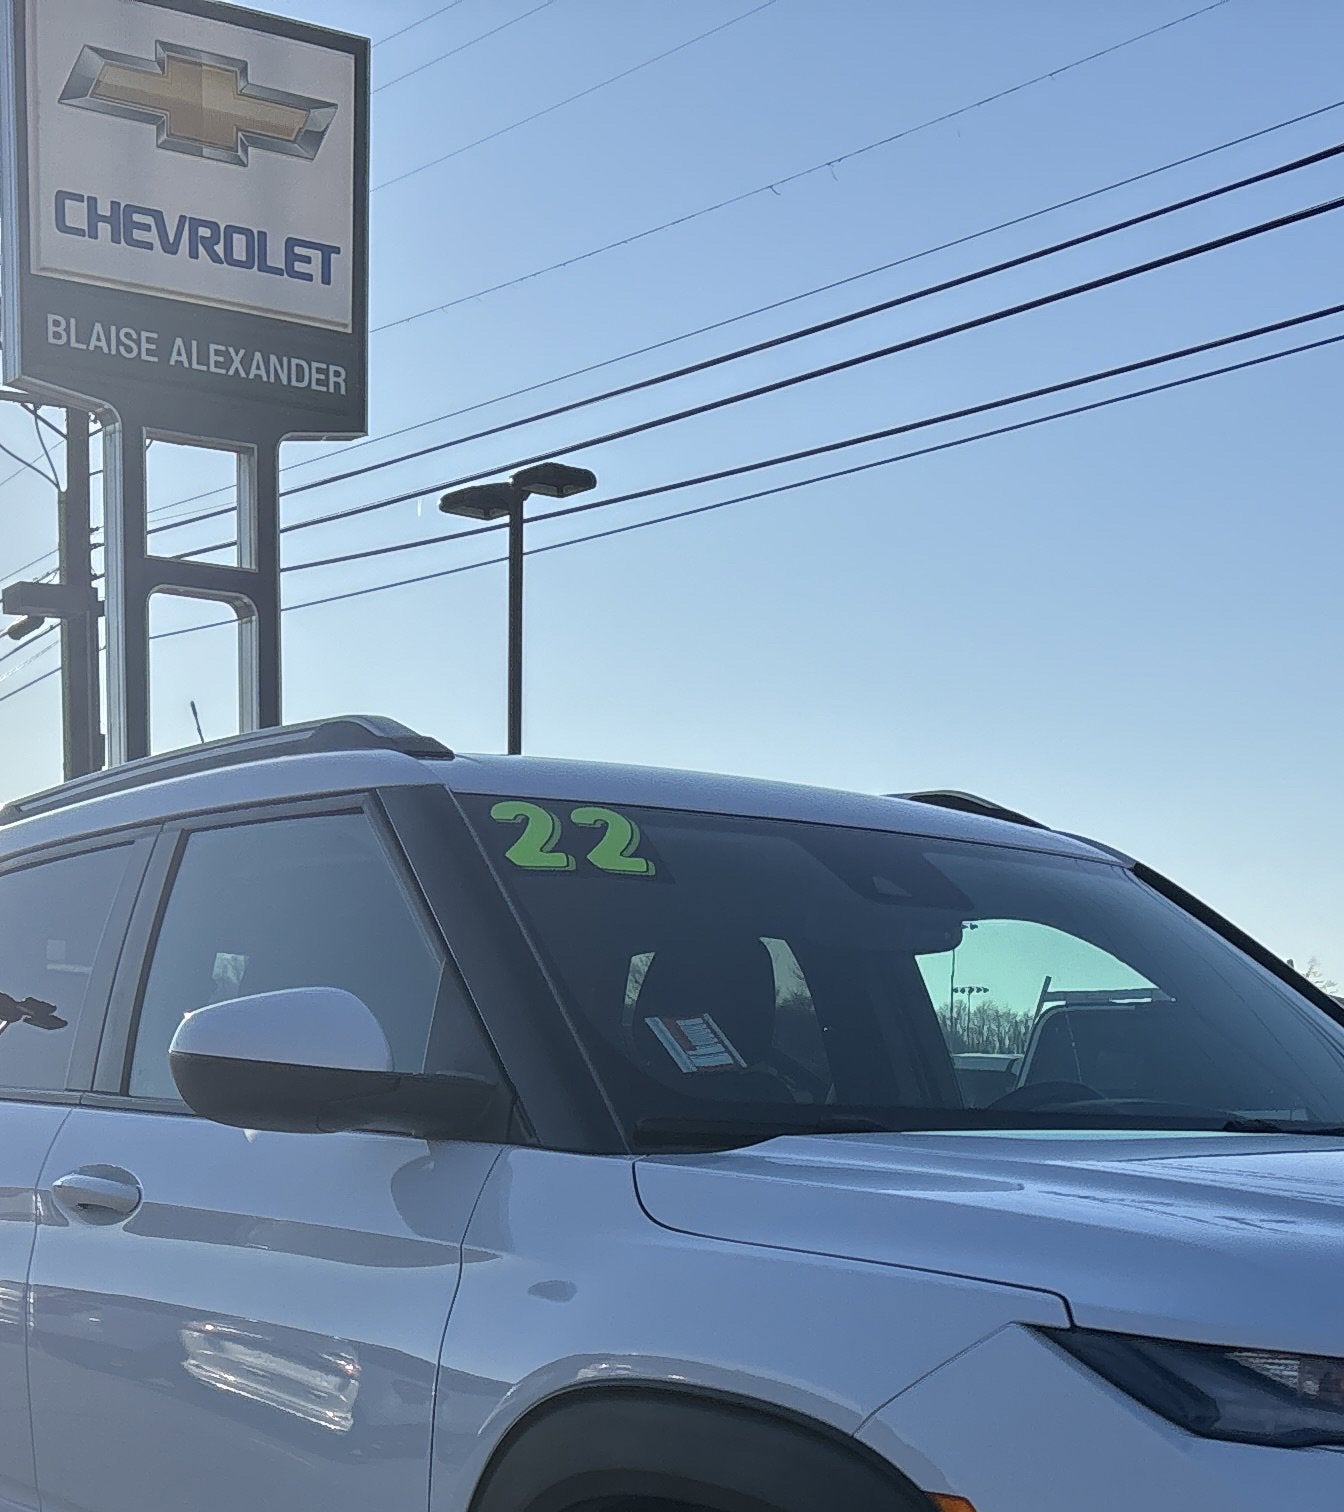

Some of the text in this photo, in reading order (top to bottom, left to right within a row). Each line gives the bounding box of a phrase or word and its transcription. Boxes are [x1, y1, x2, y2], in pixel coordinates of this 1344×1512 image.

[55, 189, 341, 286] CHEVROLET
[47, 313, 347, 396] BLAISE ALEXANDER
[490, 800, 655, 875] 22
